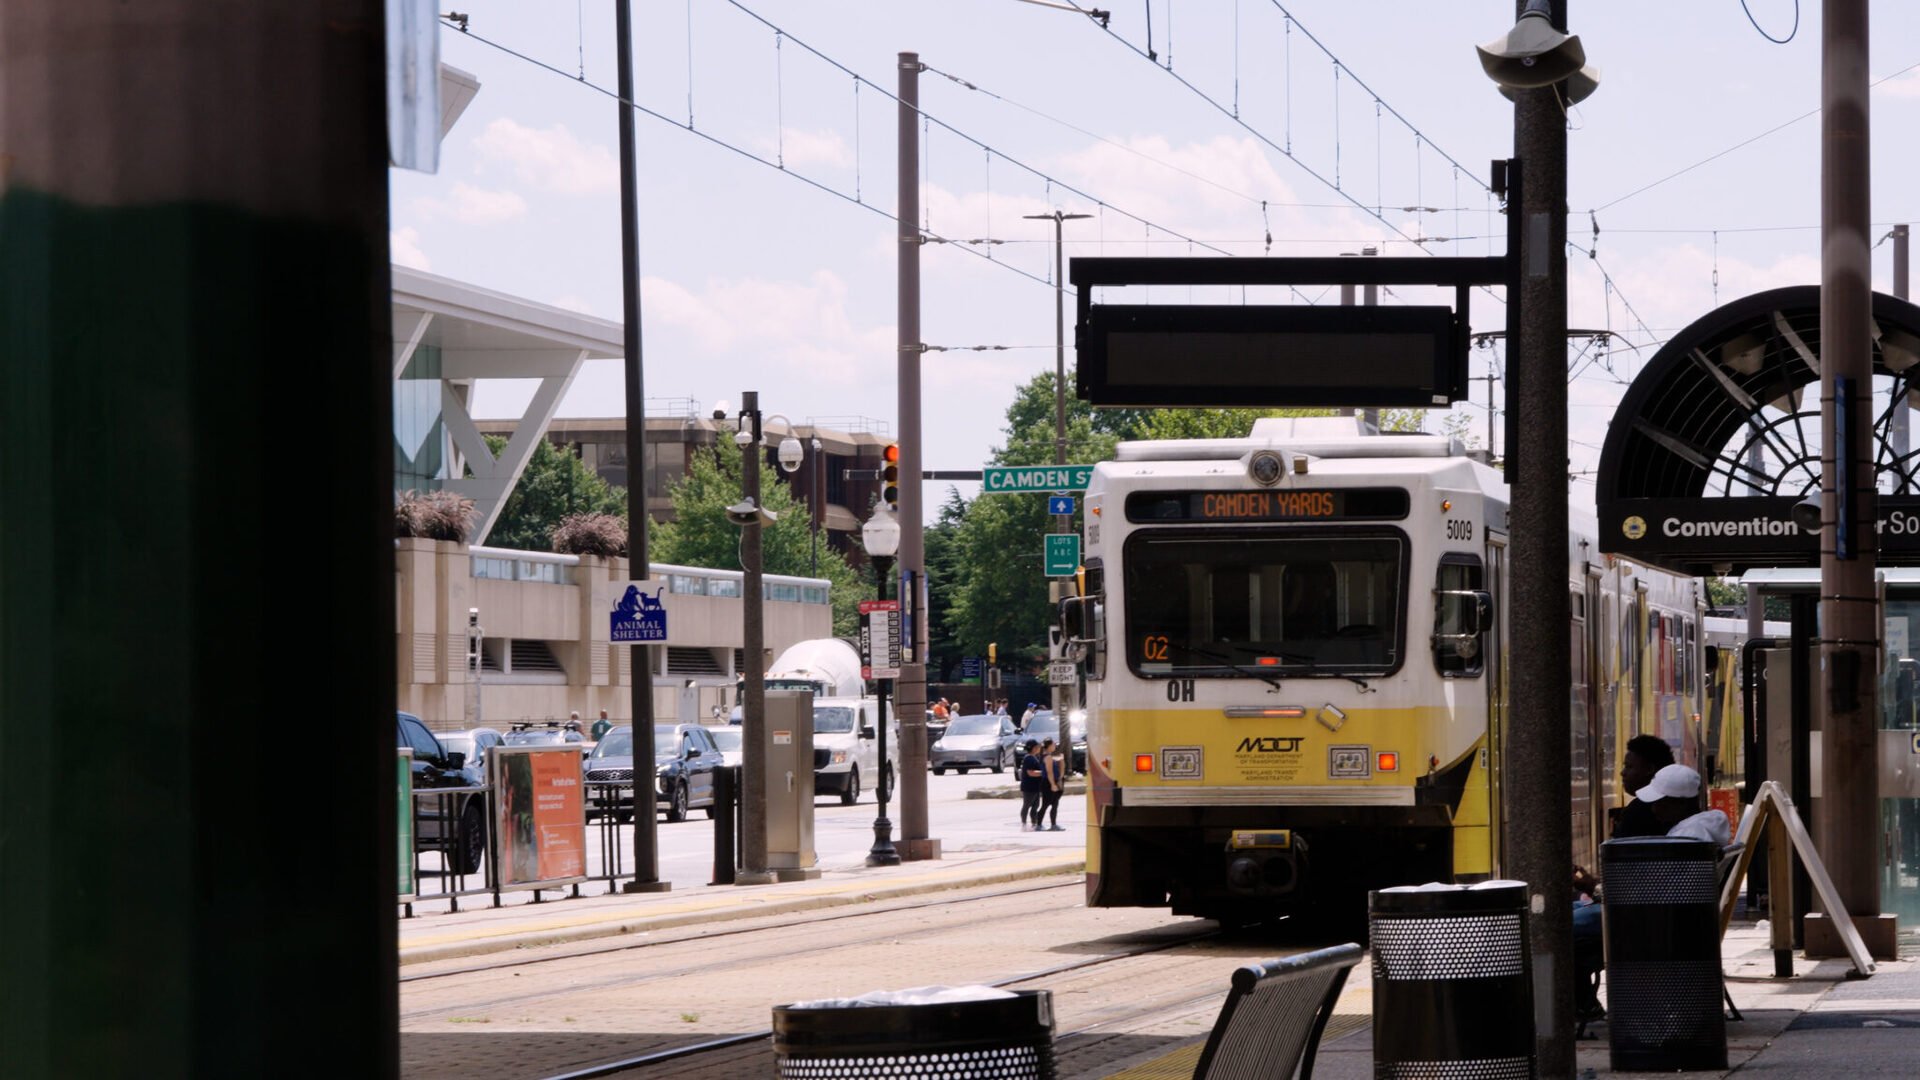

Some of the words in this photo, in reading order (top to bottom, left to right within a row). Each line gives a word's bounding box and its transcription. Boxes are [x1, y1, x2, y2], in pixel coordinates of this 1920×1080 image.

[989, 471, 1070, 489] CAMDEN
[1204, 493, 1270, 518] CAMDEN
[1278, 492, 1334, 516] YARDS
[1446, 519, 1473, 541] 5009
[1662, 517, 1798, 537] Convention
[1053, 537, 1072, 545] LOTS
[615, 620, 661, 630] ANIMAL
[613, 630, 663, 639] SHELTER
[1144, 635, 1169, 660] 02
[1053, 665, 1073, 674] KEEP
[1051, 674, 1074, 682] RIGHT
[1167, 679, 1195, 702] OH
[1236, 737, 1305, 752] MDOT
